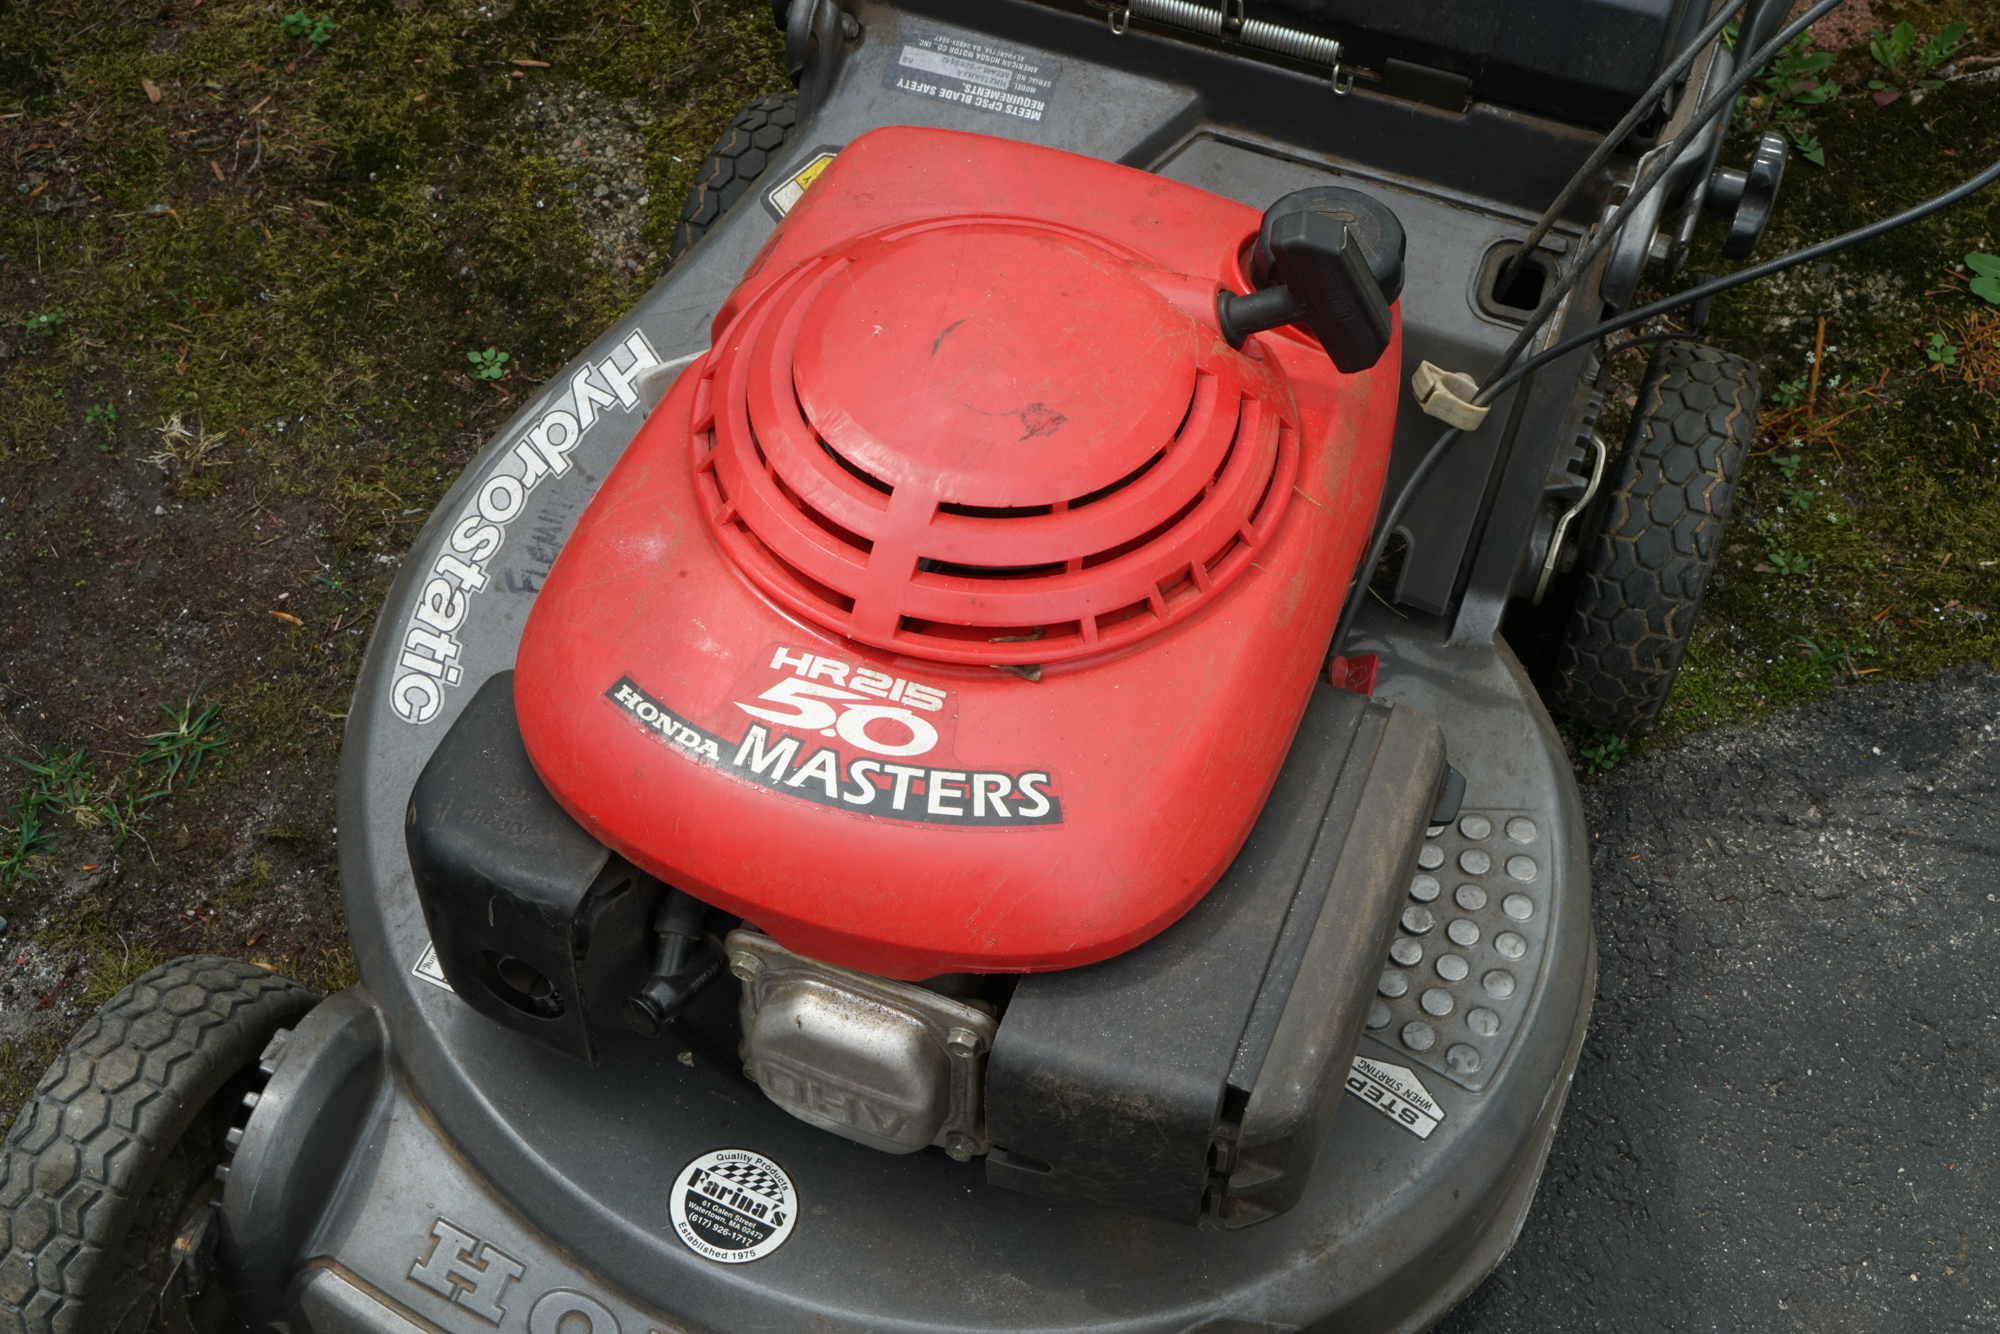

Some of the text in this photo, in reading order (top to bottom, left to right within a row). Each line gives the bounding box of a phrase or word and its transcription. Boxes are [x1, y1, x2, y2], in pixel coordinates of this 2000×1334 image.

[918, 38, 932, 48] INC.
[949, 46, 975, 60] MOTOR
[976, 52, 1000, 65] HONDA
[1002, 60, 1039, 73] AMERICAN
[1029, 74, 1053, 88] SERIAL
[897, 78, 1042, 121] MEETS CPSC BLADE SAFETY
[962, 83, 1045, 111] REQUIREMENTS.
[1012, 82, 1037, 94] MODEL:
[391, 329, 663, 723] Hydrostatic
[769, 647, 948, 712] HR215
[733, 677, 939, 757] 5.0
[613, 683, 1053, 818] HONDA MASTERS
[1346, 1076, 1420, 1126] STEP
[1357, 1059, 1433, 1111] WHEN STARTING
[716, 1153, 789, 1192] Quality Products
[687, 1167, 788, 1228] Farina's
[712, 1204, 734, 1218] Galen
[734, 1214, 757, 1229] Street
[688, 1201, 764, 1240] Watertown, MA 02472
[688, 1212, 754, 1247] (617) 926-1717
[678, 1222, 756, 1260] Established 1975
